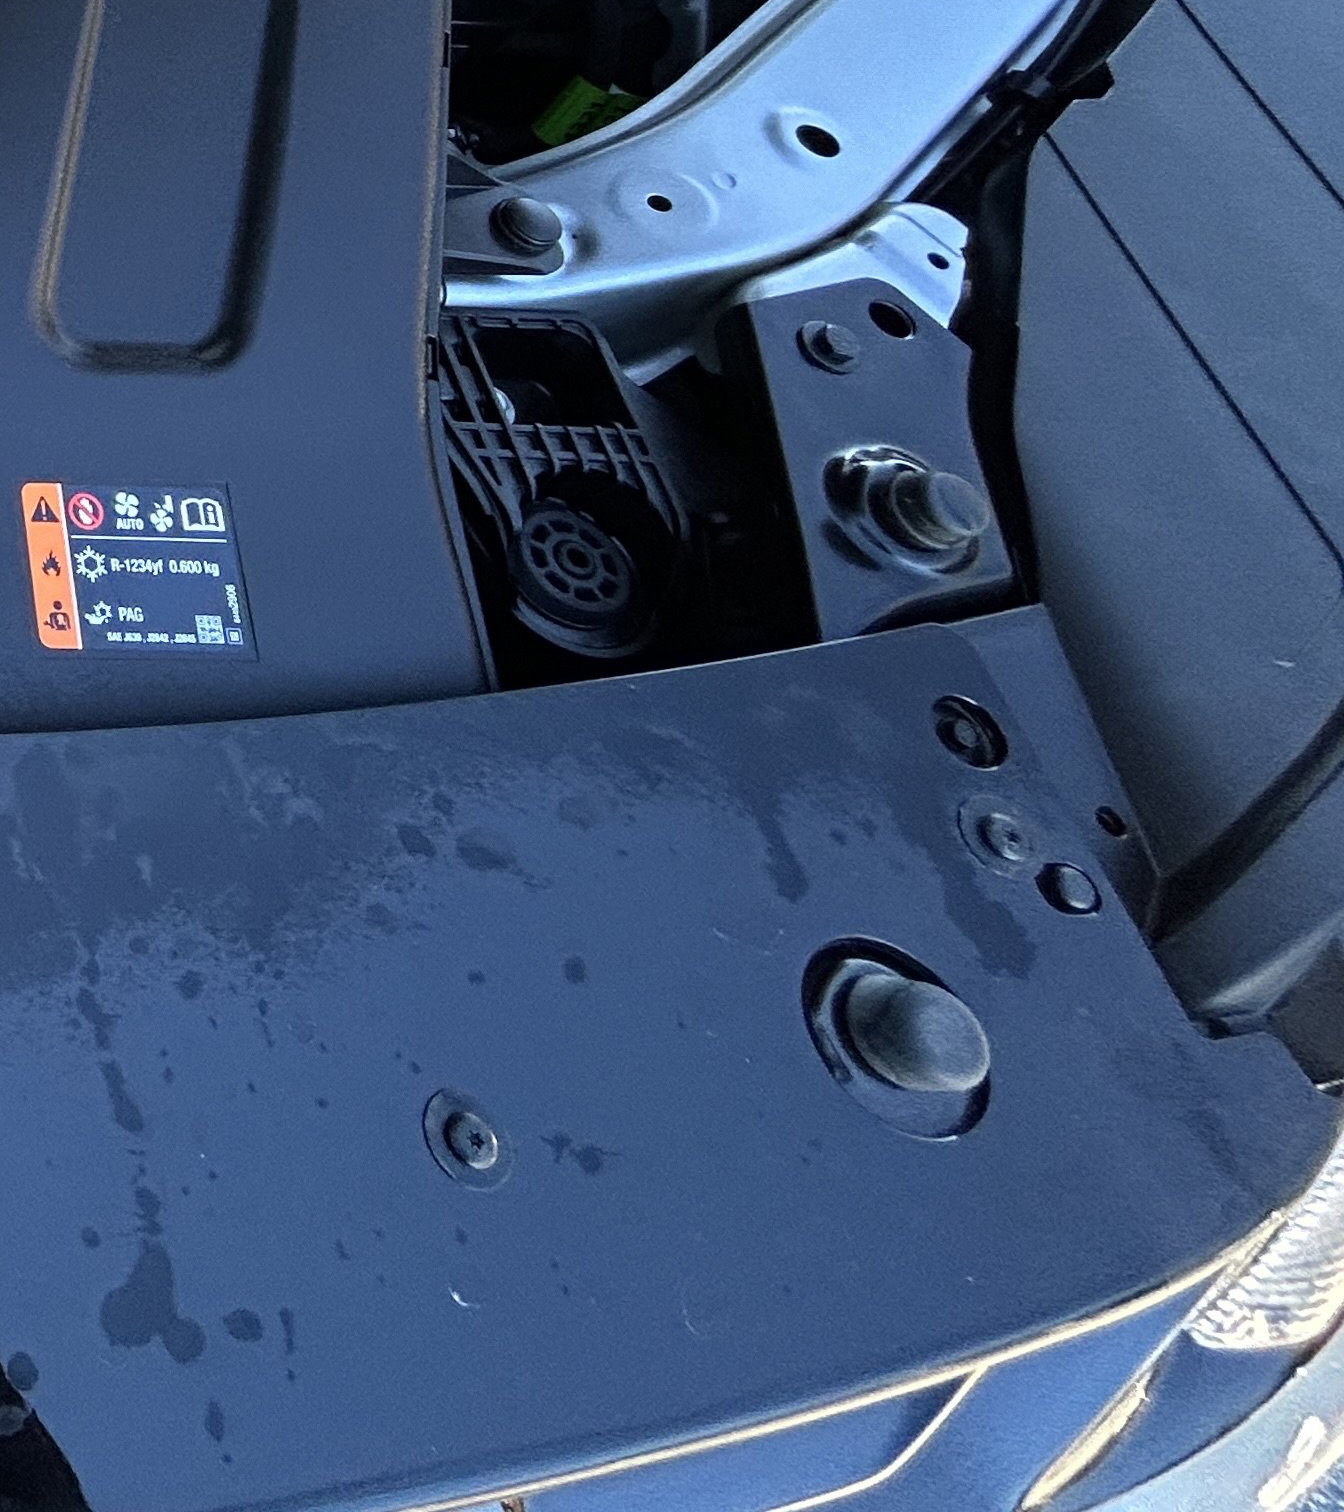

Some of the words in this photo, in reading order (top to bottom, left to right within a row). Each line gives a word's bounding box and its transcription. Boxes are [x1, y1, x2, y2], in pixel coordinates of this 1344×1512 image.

[116, 517, 144, 530] AUTO
[110, 558, 164, 577] R-1234yf
[168, 559, 202, 574] 0.600
[204, 560, 220, 577] kg
[118, 606, 144, 622] PAG
